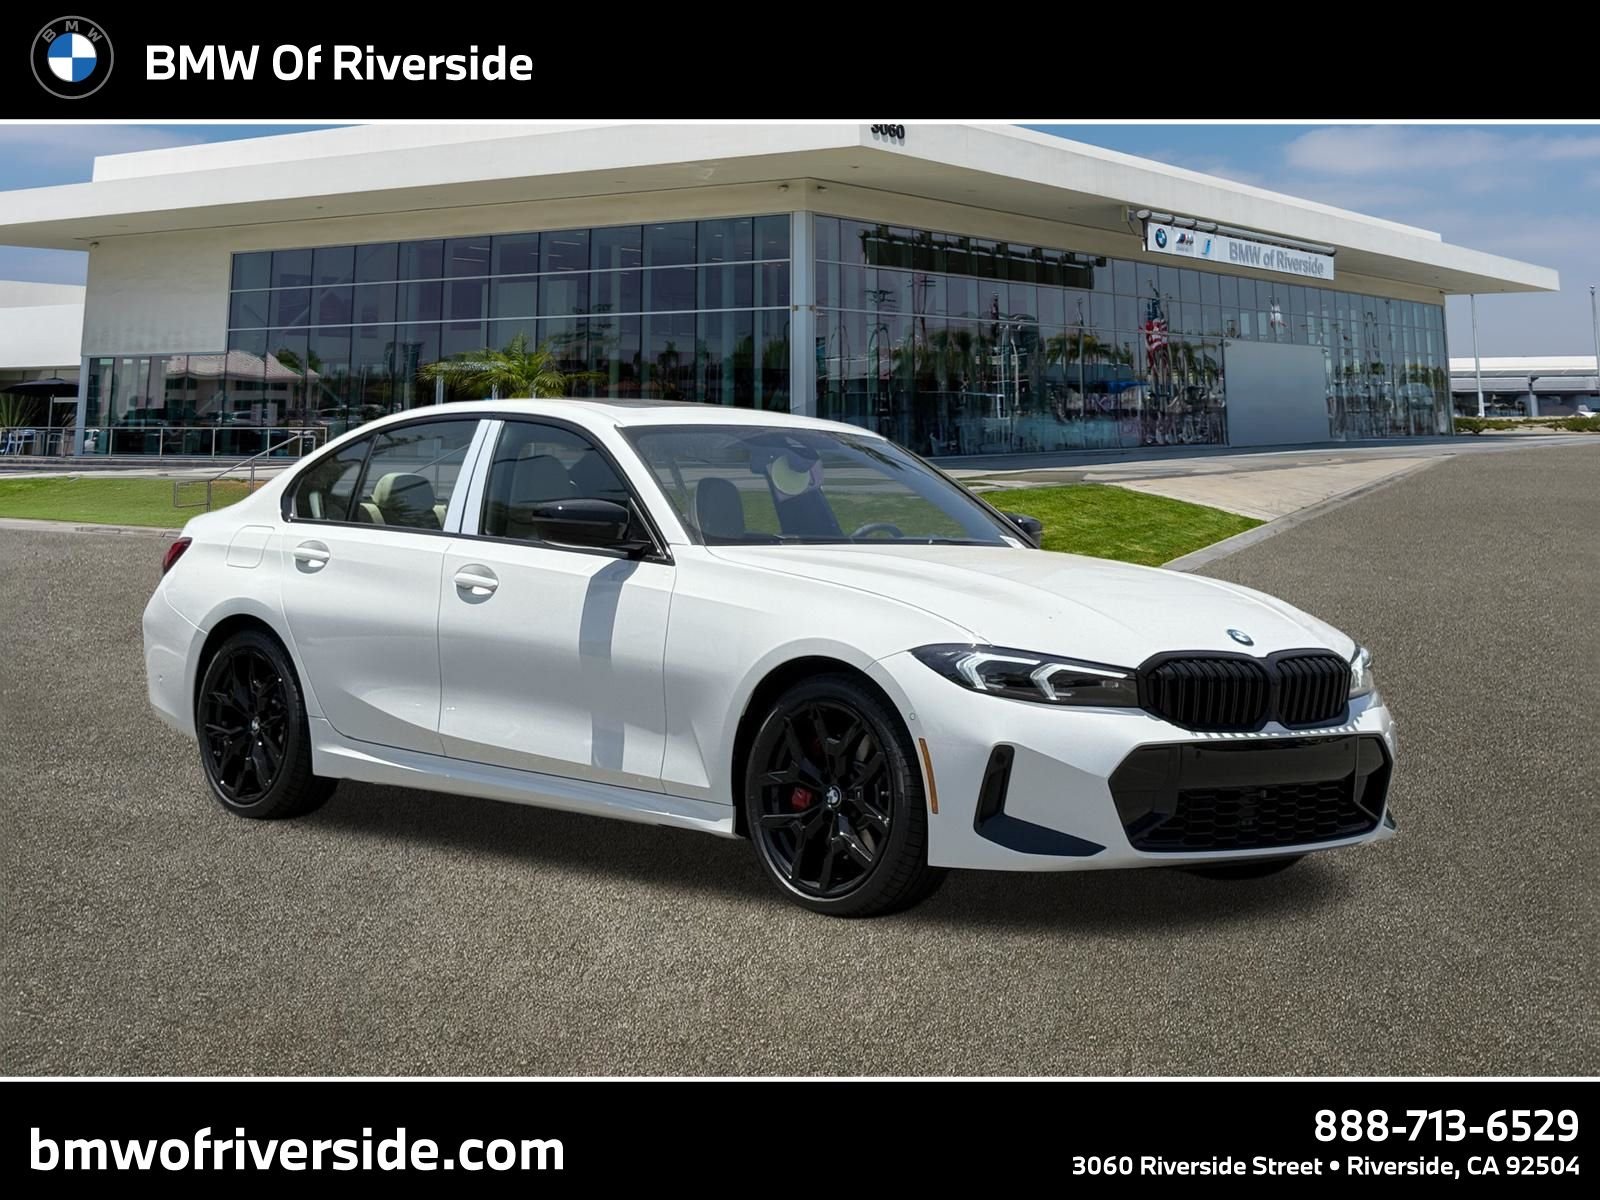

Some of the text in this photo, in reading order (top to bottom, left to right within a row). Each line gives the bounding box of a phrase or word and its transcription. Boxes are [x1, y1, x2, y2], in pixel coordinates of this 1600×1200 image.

[1229, 241, 1261, 265] BMW
[1263, 249, 1275, 267] of
[1276, 250, 1324, 275] Riverside
